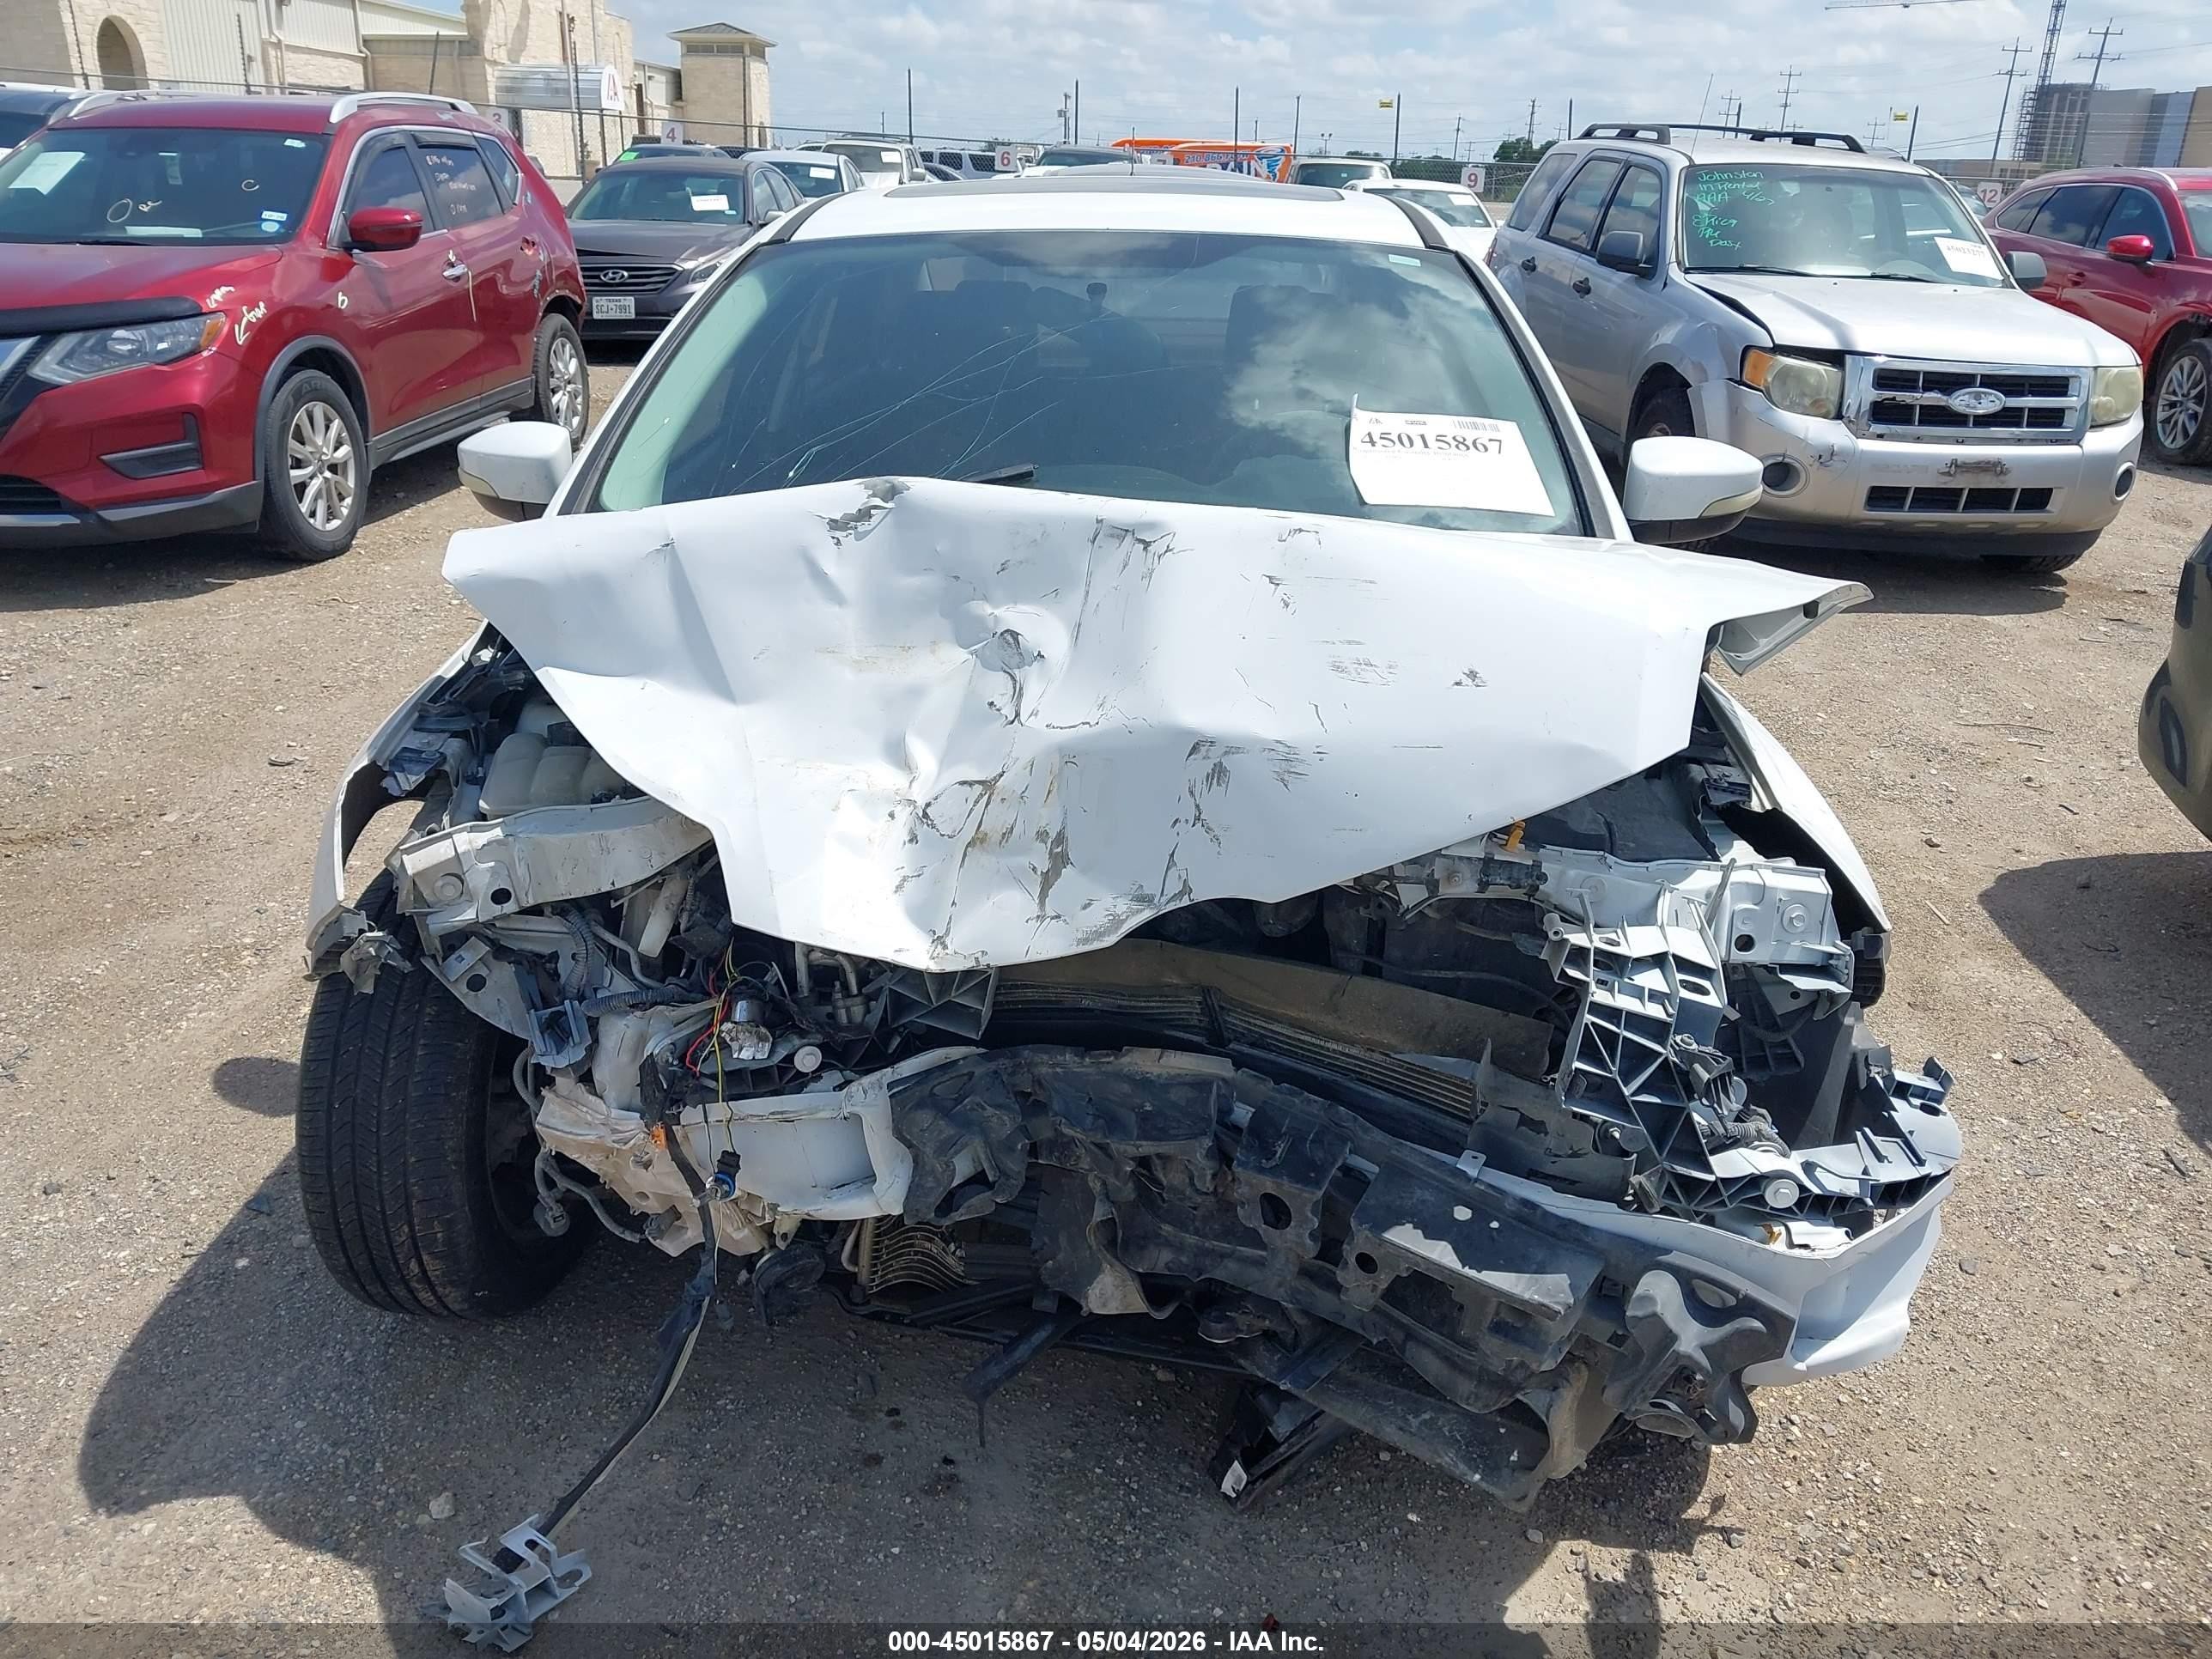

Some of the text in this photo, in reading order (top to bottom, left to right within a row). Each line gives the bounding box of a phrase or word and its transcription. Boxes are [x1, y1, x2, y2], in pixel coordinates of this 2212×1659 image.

[665, 126, 677, 143] 4
[1000, 150, 1011, 167] 6
[1468, 172, 1478, 188] 9
[1980, 188, 1998, 204] 12
[1360, 431, 1503, 455] 45015867
